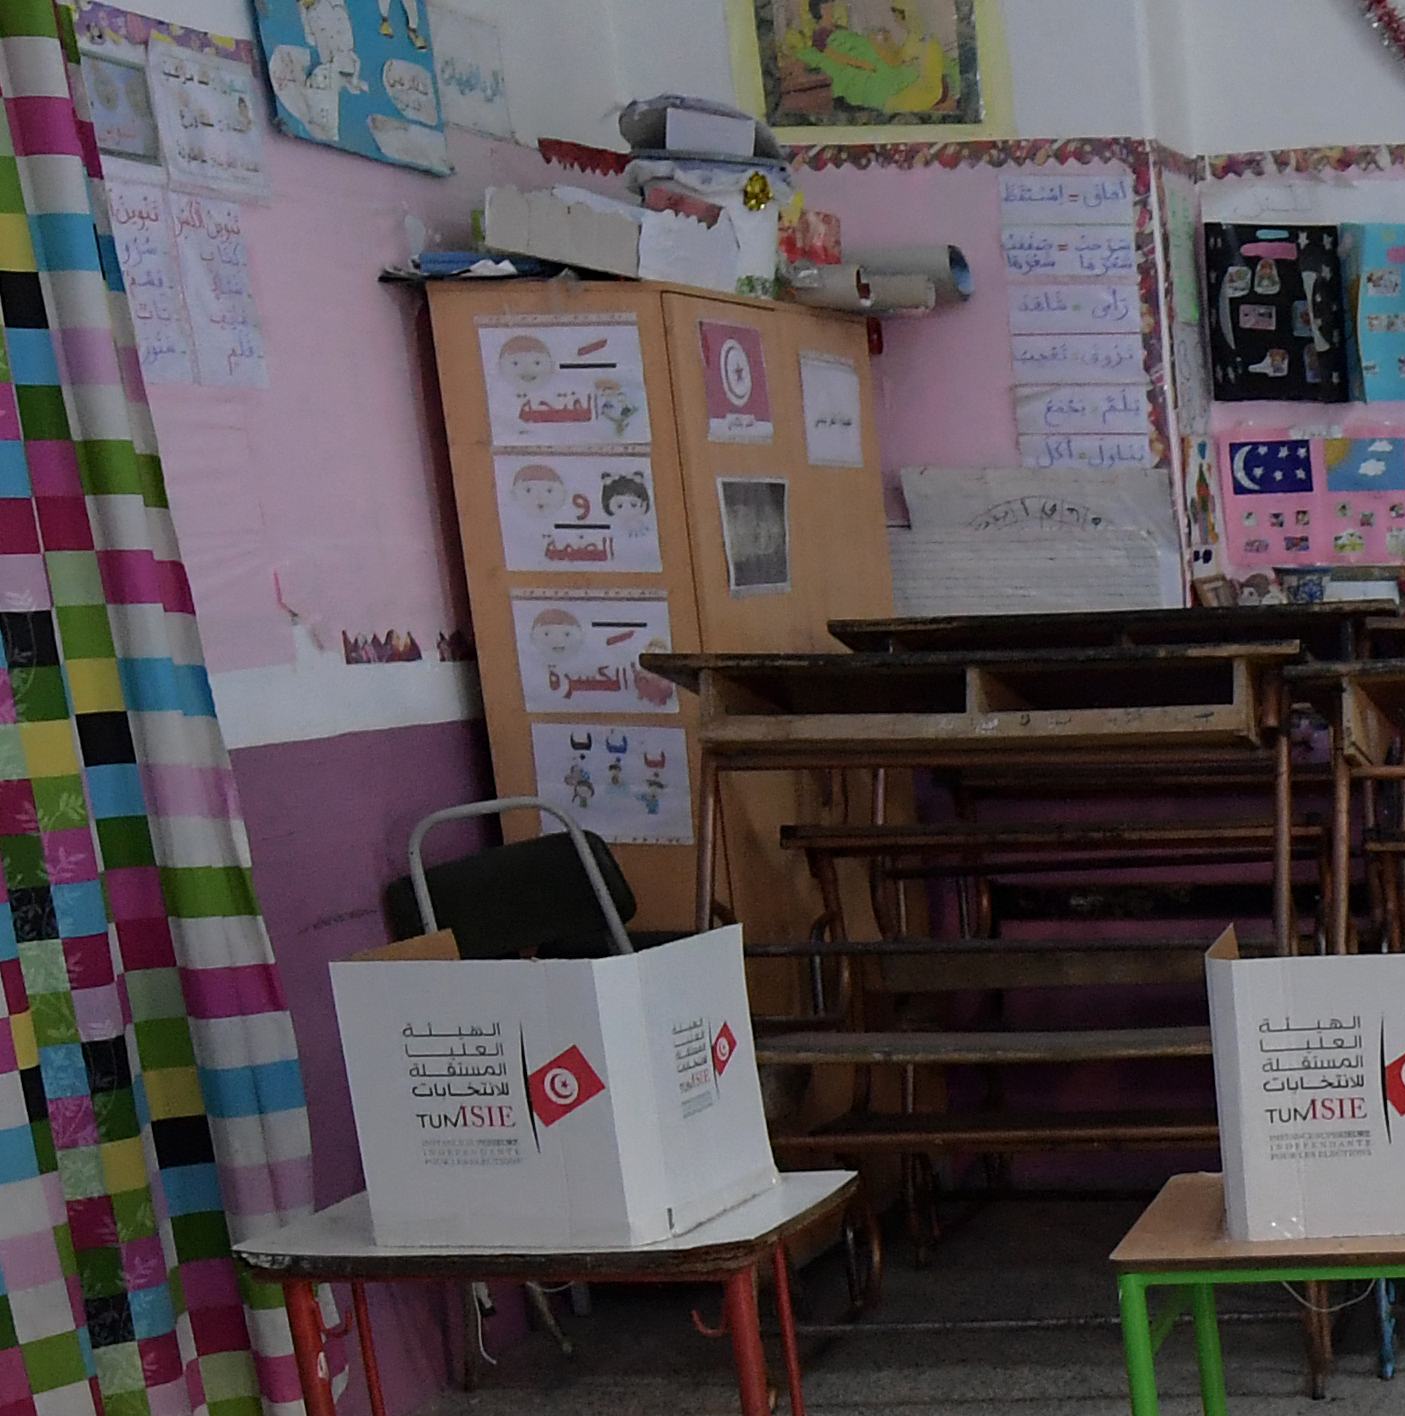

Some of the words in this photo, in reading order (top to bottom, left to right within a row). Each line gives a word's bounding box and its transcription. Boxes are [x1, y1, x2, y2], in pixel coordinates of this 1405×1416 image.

[518, 391, 598, 422] الفتحة
[544, 534, 614, 561] الضمة
[548, 665, 628, 699] الكسرة
[402, 1022, 501, 1039] الهيئة
[1258, 1015, 1361, 1033] الهيئة
[404, 1042, 504, 1062] العليا
[1260, 1035, 1362, 1053] العليا
[409, 1062, 507, 1079] المستقلة
[1262, 1054, 1364, 1073] المستقلة
[411, 1081, 510, 1099] للانتخابات
[1263, 1074, 1364, 1093] للانتخابات
